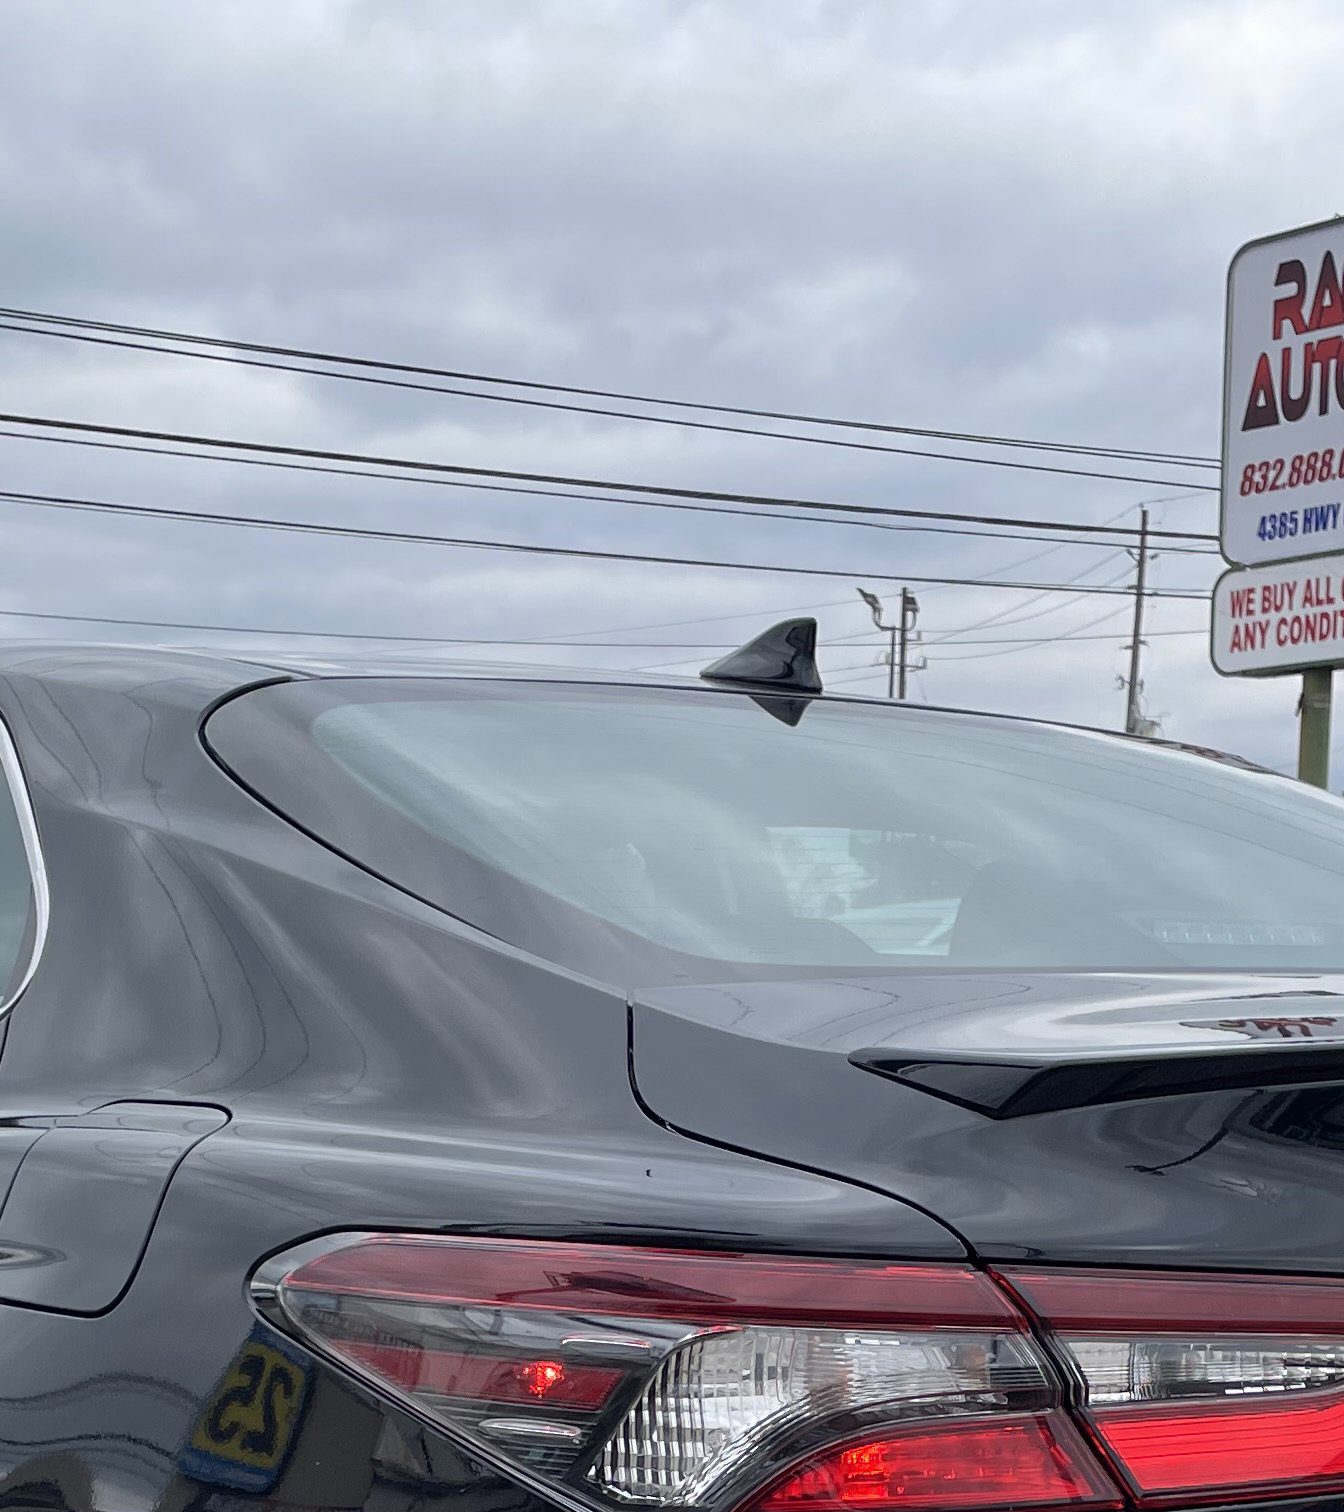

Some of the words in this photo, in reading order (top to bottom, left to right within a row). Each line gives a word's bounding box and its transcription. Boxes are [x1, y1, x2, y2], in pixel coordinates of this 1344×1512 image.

[1257, 510, 1298, 541] 4385
[1303, 503, 1341, 535] HWY
[1231, 588, 1256, 619] WE
[1262, 581, 1297, 614] BUY
[1302, 576, 1336, 608] ALL
[1230, 619, 1270, 653] ANY
